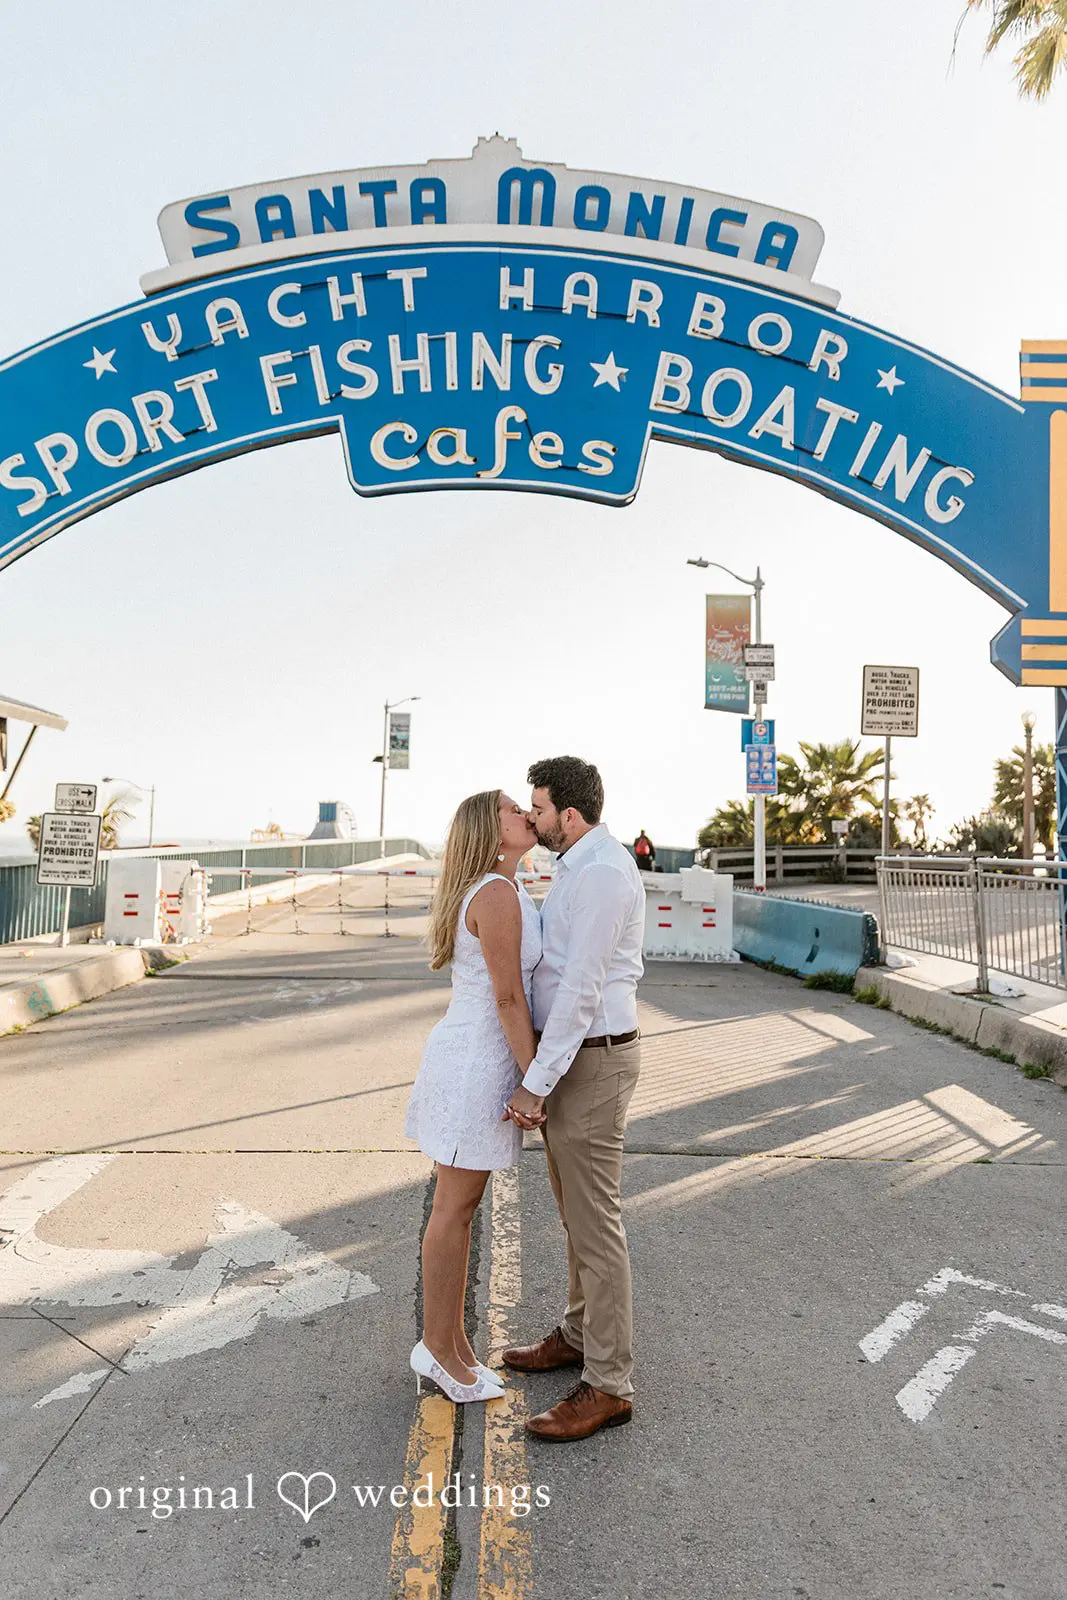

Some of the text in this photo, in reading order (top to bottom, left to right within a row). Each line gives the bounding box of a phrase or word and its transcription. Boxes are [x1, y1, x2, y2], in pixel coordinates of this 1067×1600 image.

[184, 166, 800, 271] SANTA MONICA
[141, 265, 849, 382] YACHT HARBOR
[0, 331, 976, 525] SPORT FISHING BOATING
[369, 405, 618, 479] cafes
[866, 698, 915, 708] PROHIBITED
[44, 847, 94, 857] PROHIBITED
